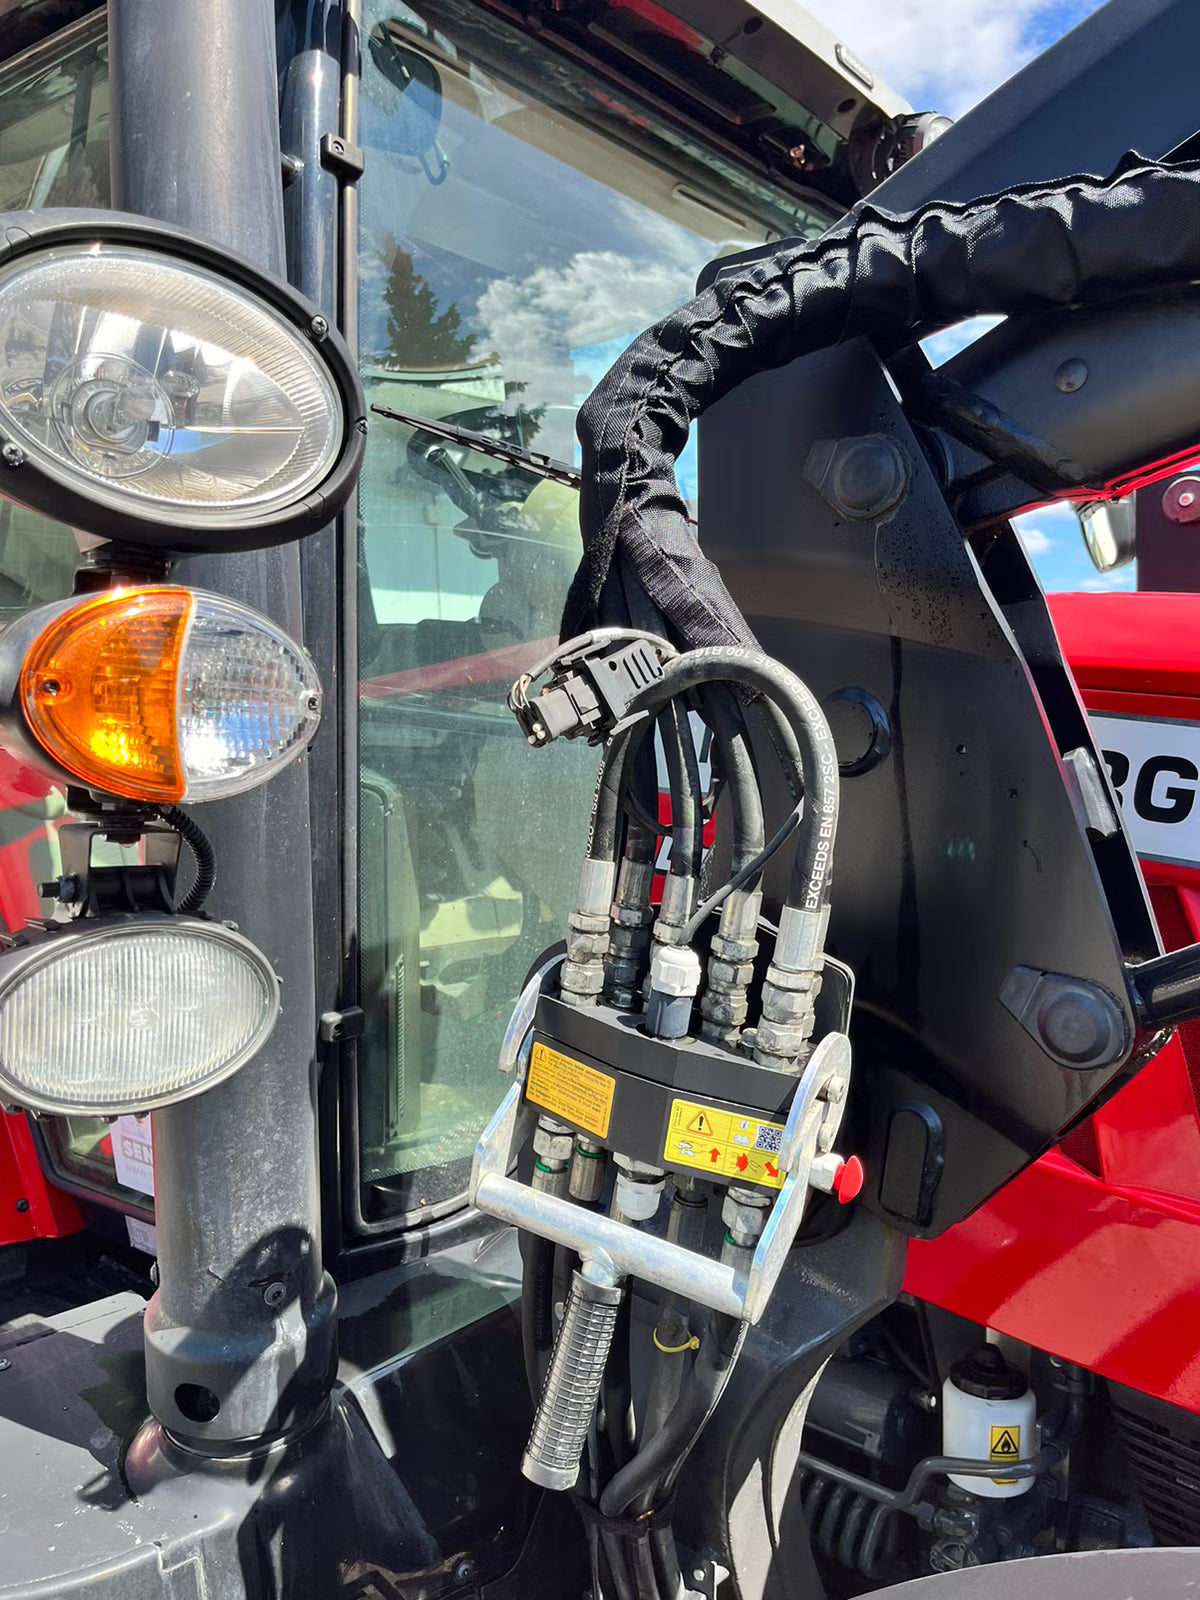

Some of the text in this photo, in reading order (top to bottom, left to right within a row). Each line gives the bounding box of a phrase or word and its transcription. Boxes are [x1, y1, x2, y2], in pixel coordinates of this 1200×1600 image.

[725, 648, 750, 660] 100
[753, 654, 784, 676] SAE
[784, 672, 828, 741] EXCEEDS
[821, 752, 835, 784] 2SC
[822, 788, 835, 814] 857
[819, 816, 834, 838] EN
[805, 841, 830, 909] EXCEEDS
